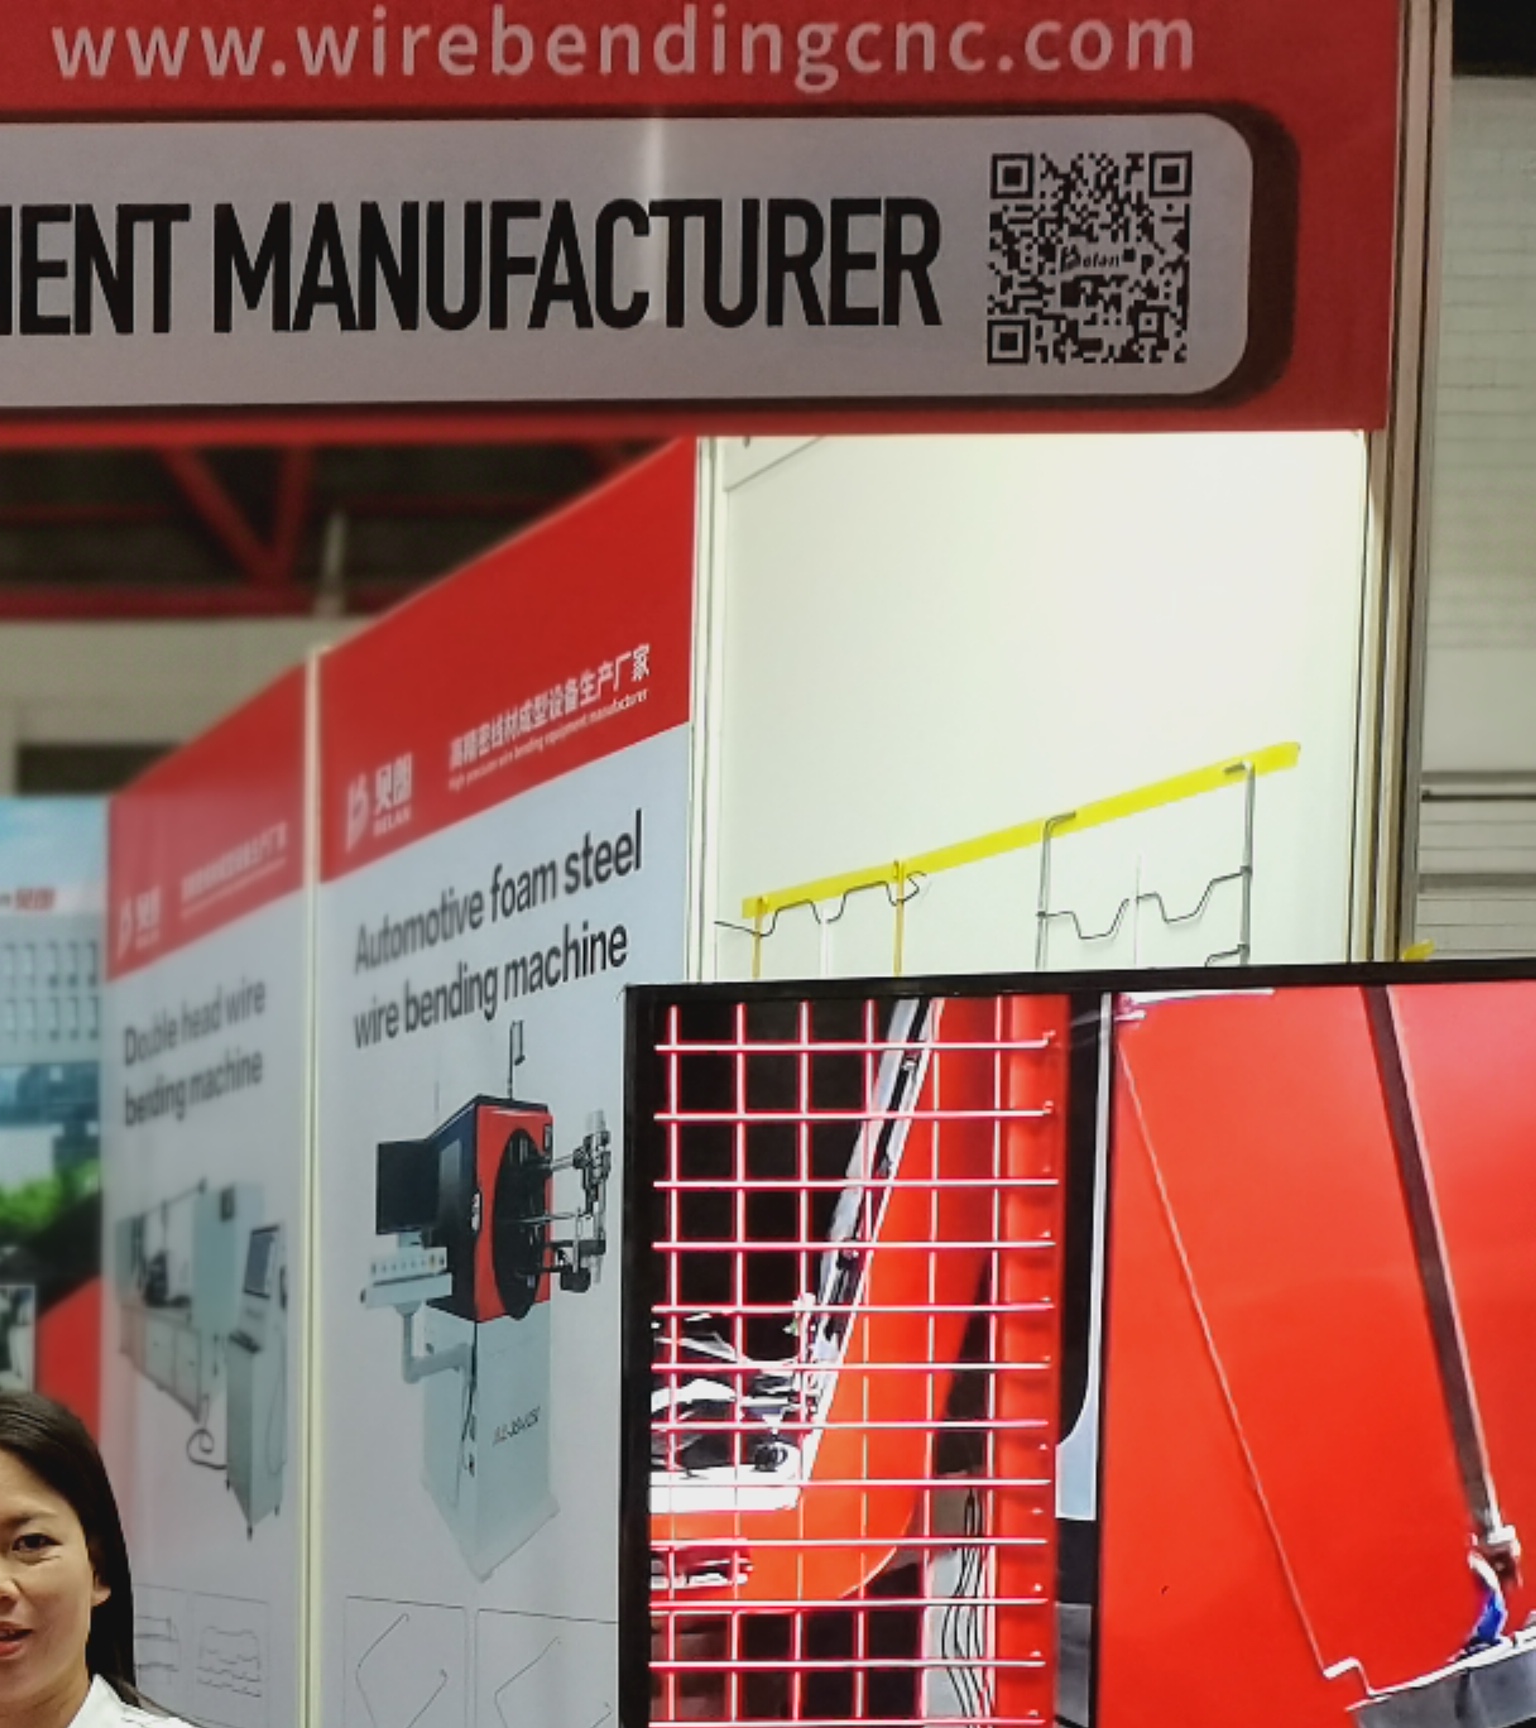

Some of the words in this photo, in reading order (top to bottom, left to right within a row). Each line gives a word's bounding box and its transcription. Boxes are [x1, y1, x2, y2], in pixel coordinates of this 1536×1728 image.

[51, 8, 1195, 94] www.wirebendingcnc.com
[213, 197, 943, 336] MANUFACTURER
[354, 880, 484, 975] Automotive
[490, 858, 557, 923] foam
[563, 807, 642, 897] steel
[124, 1008, 177, 1068] Double
[181, 983, 221, 1045] head
[224, 972, 266, 1025] wire
[354, 995, 398, 1050] wire
[404, 955, 498, 1022] bending
[504, 922, 628, 1003] machine
[189, 1047, 264, 1103] machine
